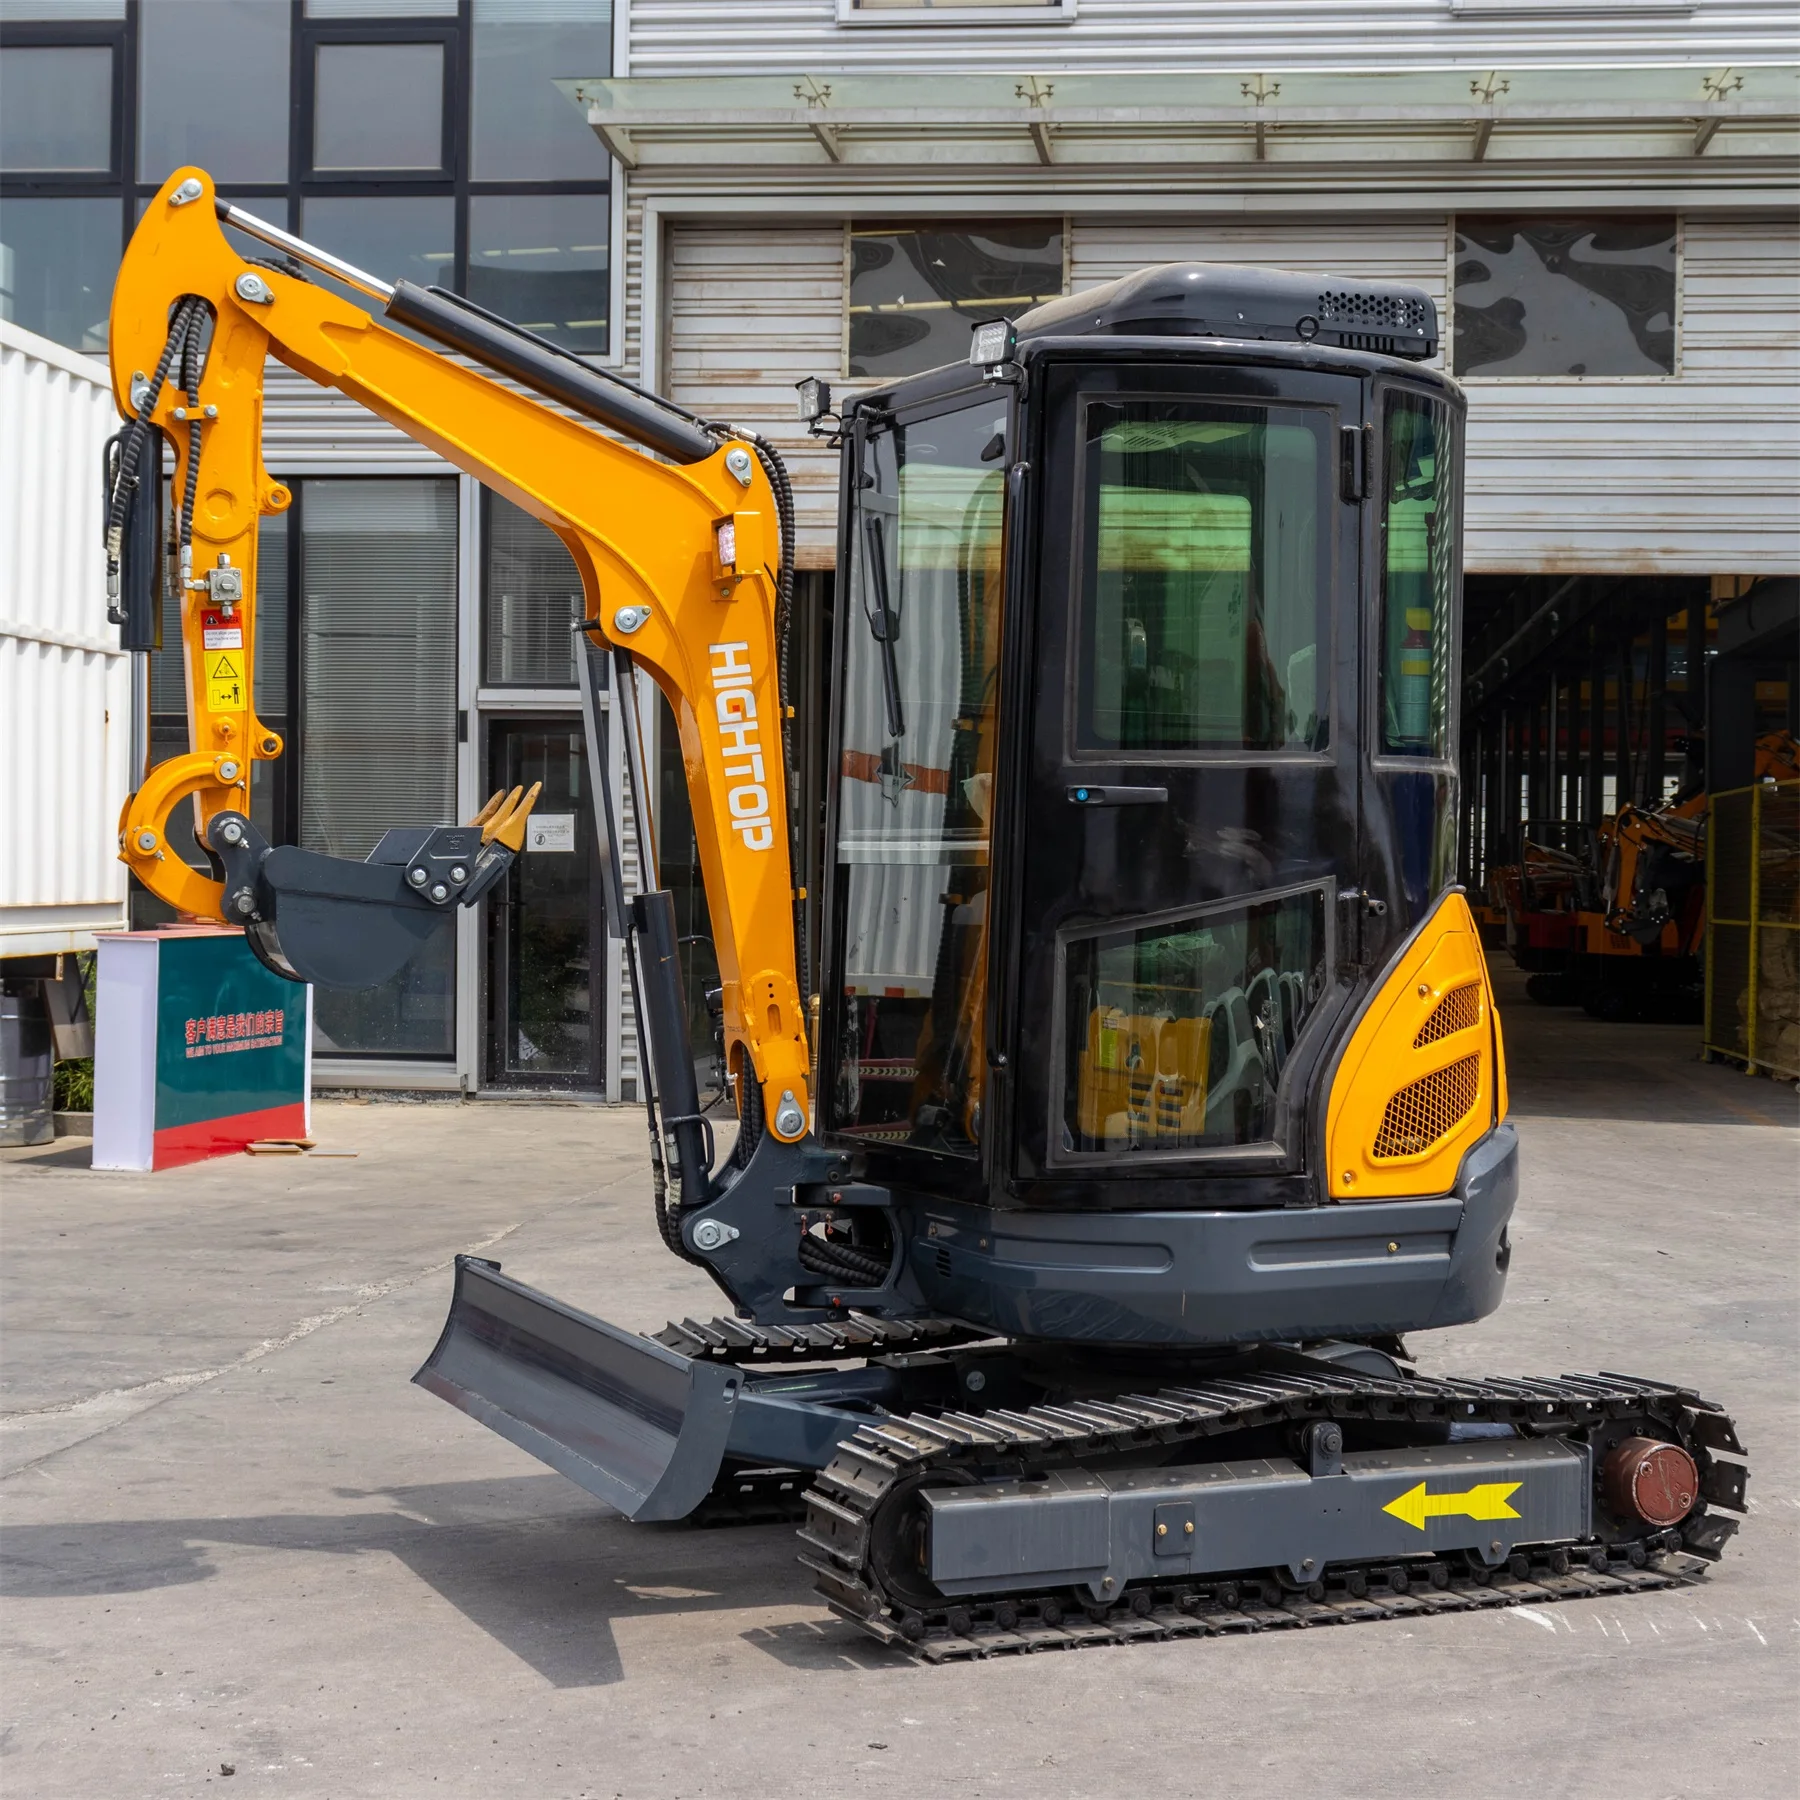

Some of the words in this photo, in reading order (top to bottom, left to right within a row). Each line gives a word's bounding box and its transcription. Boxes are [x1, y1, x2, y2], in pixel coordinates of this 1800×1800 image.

[709, 641, 773, 850] HIGHTOP
[185, 1009, 284, 1045] 客户满意是我们的宗旨
